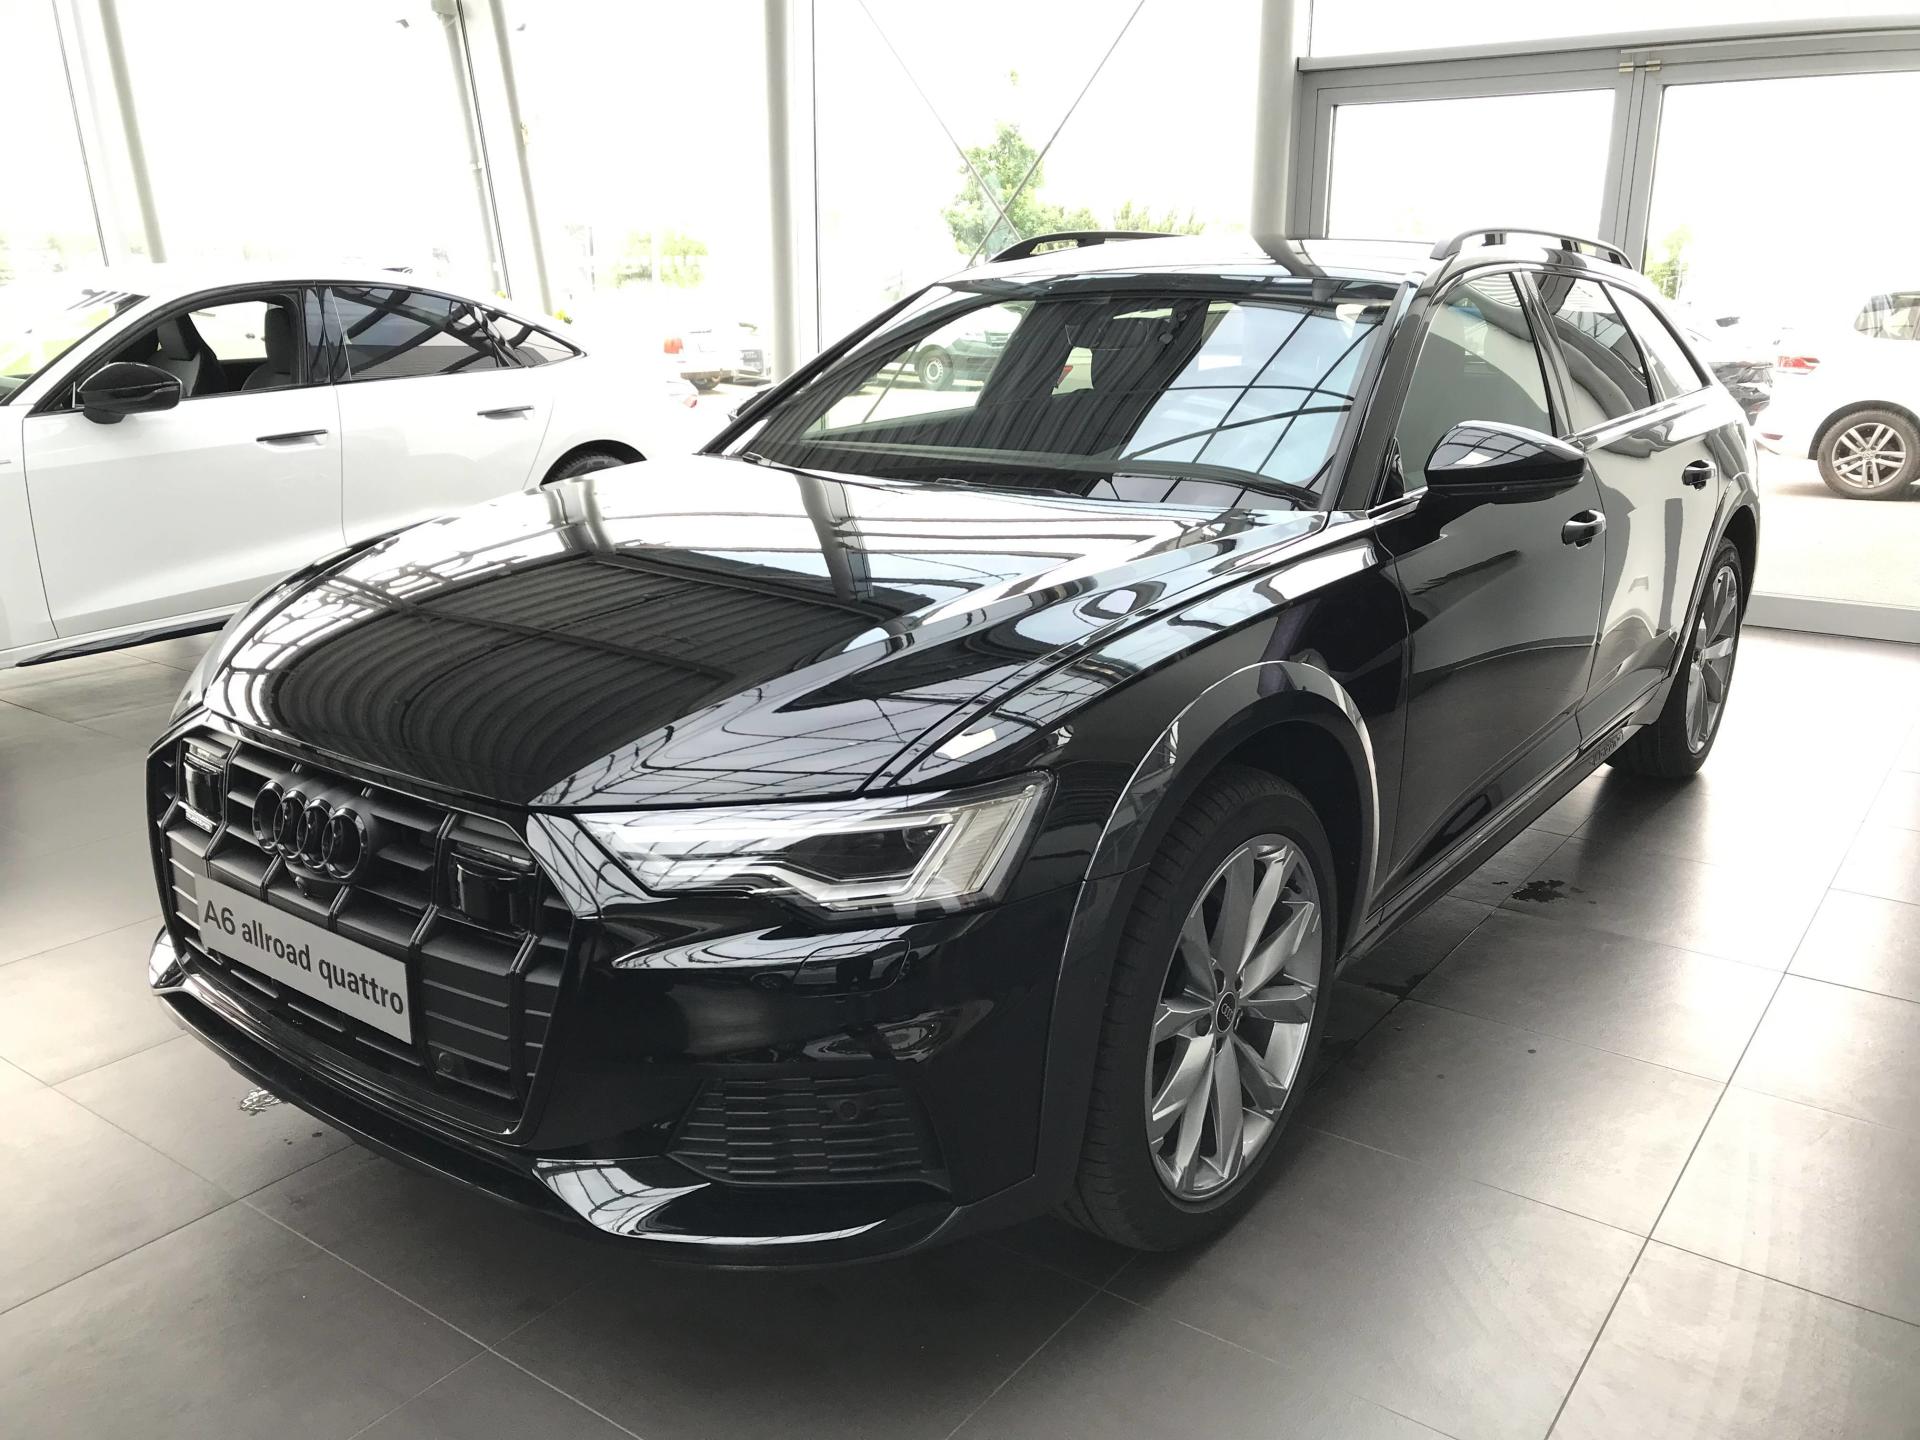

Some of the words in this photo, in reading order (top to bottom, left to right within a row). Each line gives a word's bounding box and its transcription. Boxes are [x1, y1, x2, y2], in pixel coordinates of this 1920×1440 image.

[203, 899, 236, 936] A6
[241, 919, 312, 973] allroad
[318, 958, 404, 1015] quattro
